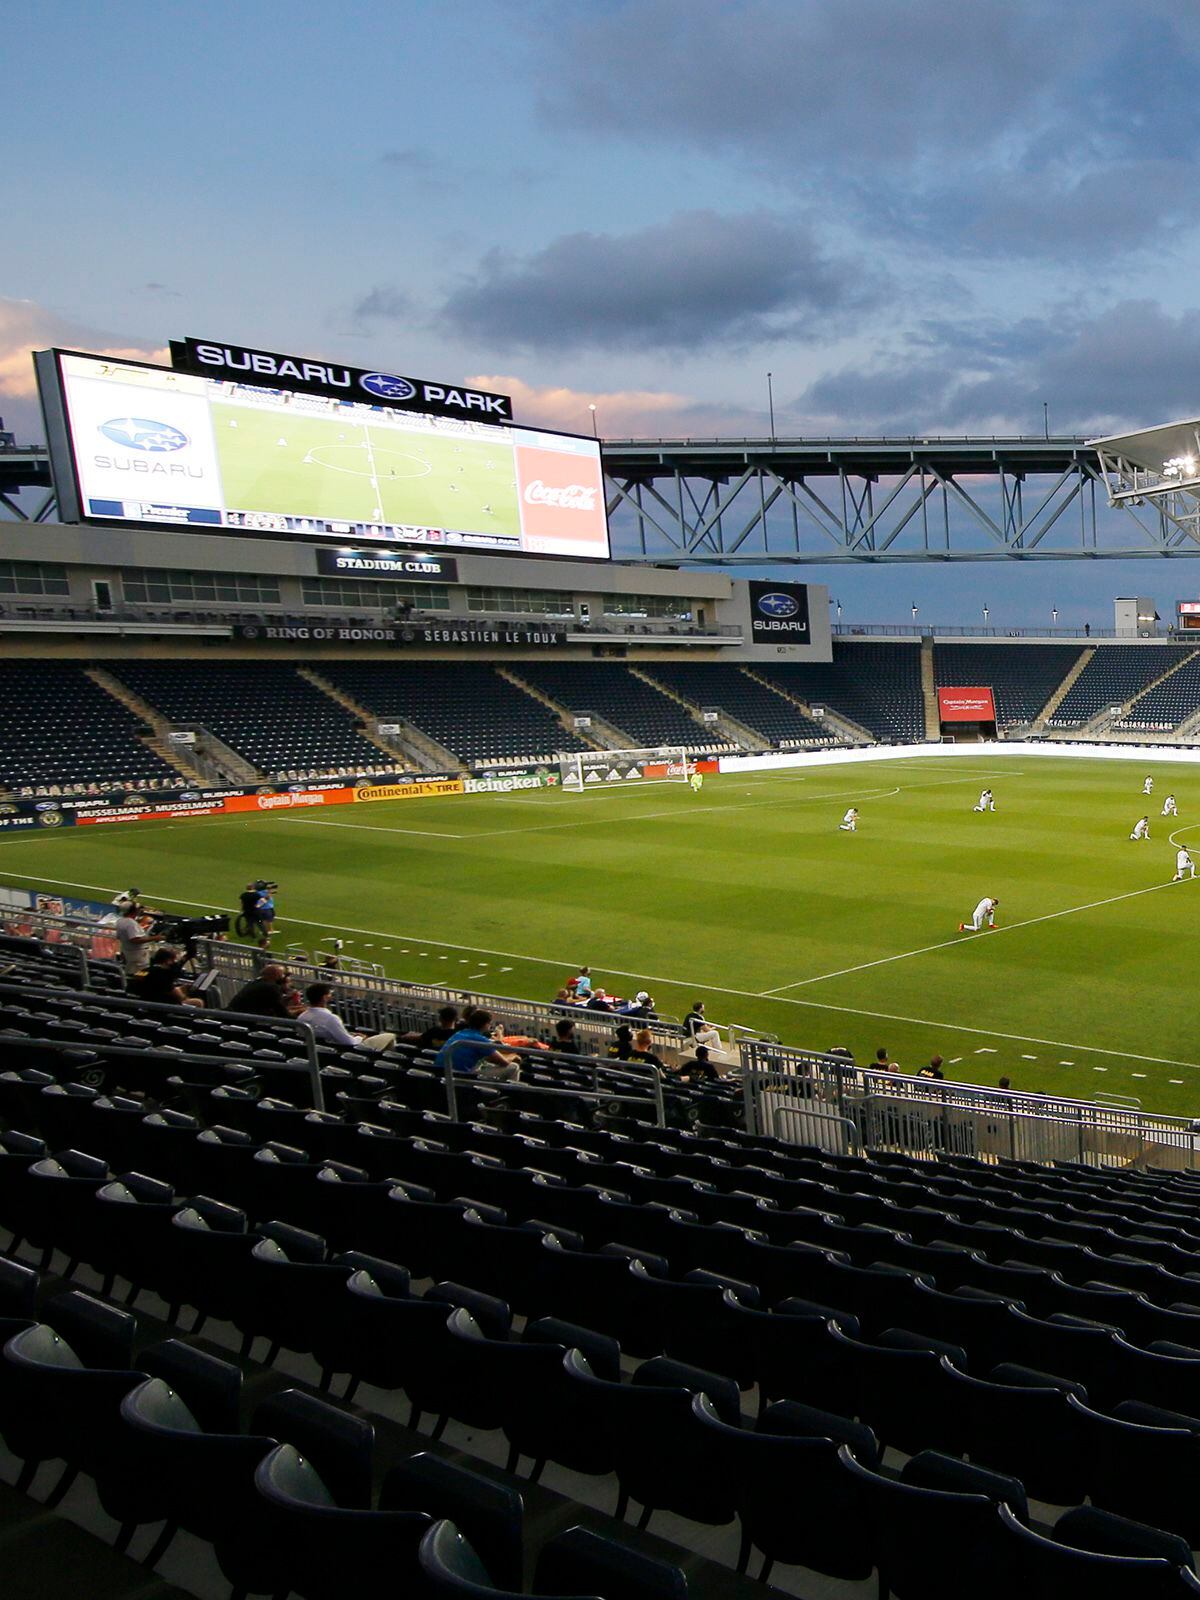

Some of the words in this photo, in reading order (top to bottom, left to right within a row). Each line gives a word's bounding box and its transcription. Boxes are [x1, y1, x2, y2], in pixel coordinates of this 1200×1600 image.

[196, 344, 351, 387] SUBARU
[423, 384, 507, 415] PARK
[94, 455, 204, 478] SUBARU
[336, 557, 403, 571] STADIUM
[404, 562, 441, 574] CLUB
[753, 620, 807, 632] SUBARU
[266, 626, 310, 639] RING
[313, 628, 335, 640] OF
[338, 628, 397, 641] HONOR
[425, 630, 499, 643] SEBASTIEN
[506, 631, 520, 643] LE
[526, 632, 558, 644] TOUX
[415, 775, 449, 783] SUBARU
[464, 775, 541, 794] Heineken
[308, 782, 345, 791] SUBARU
[357, 782, 423, 801] Continental
[436, 783, 460, 792] TIRE
[202, 790, 244, 799] SUBARU
[257, 794, 290, 810] Captain
[289, 792, 324, 805] Morgan
[61, 799, 110, 809] SUBARU
[155, 799, 224, 812] MUSSELMAN'S
[77, 806, 151, 818] MUSSELMAN'S
[12, 816, 35, 825] THE
